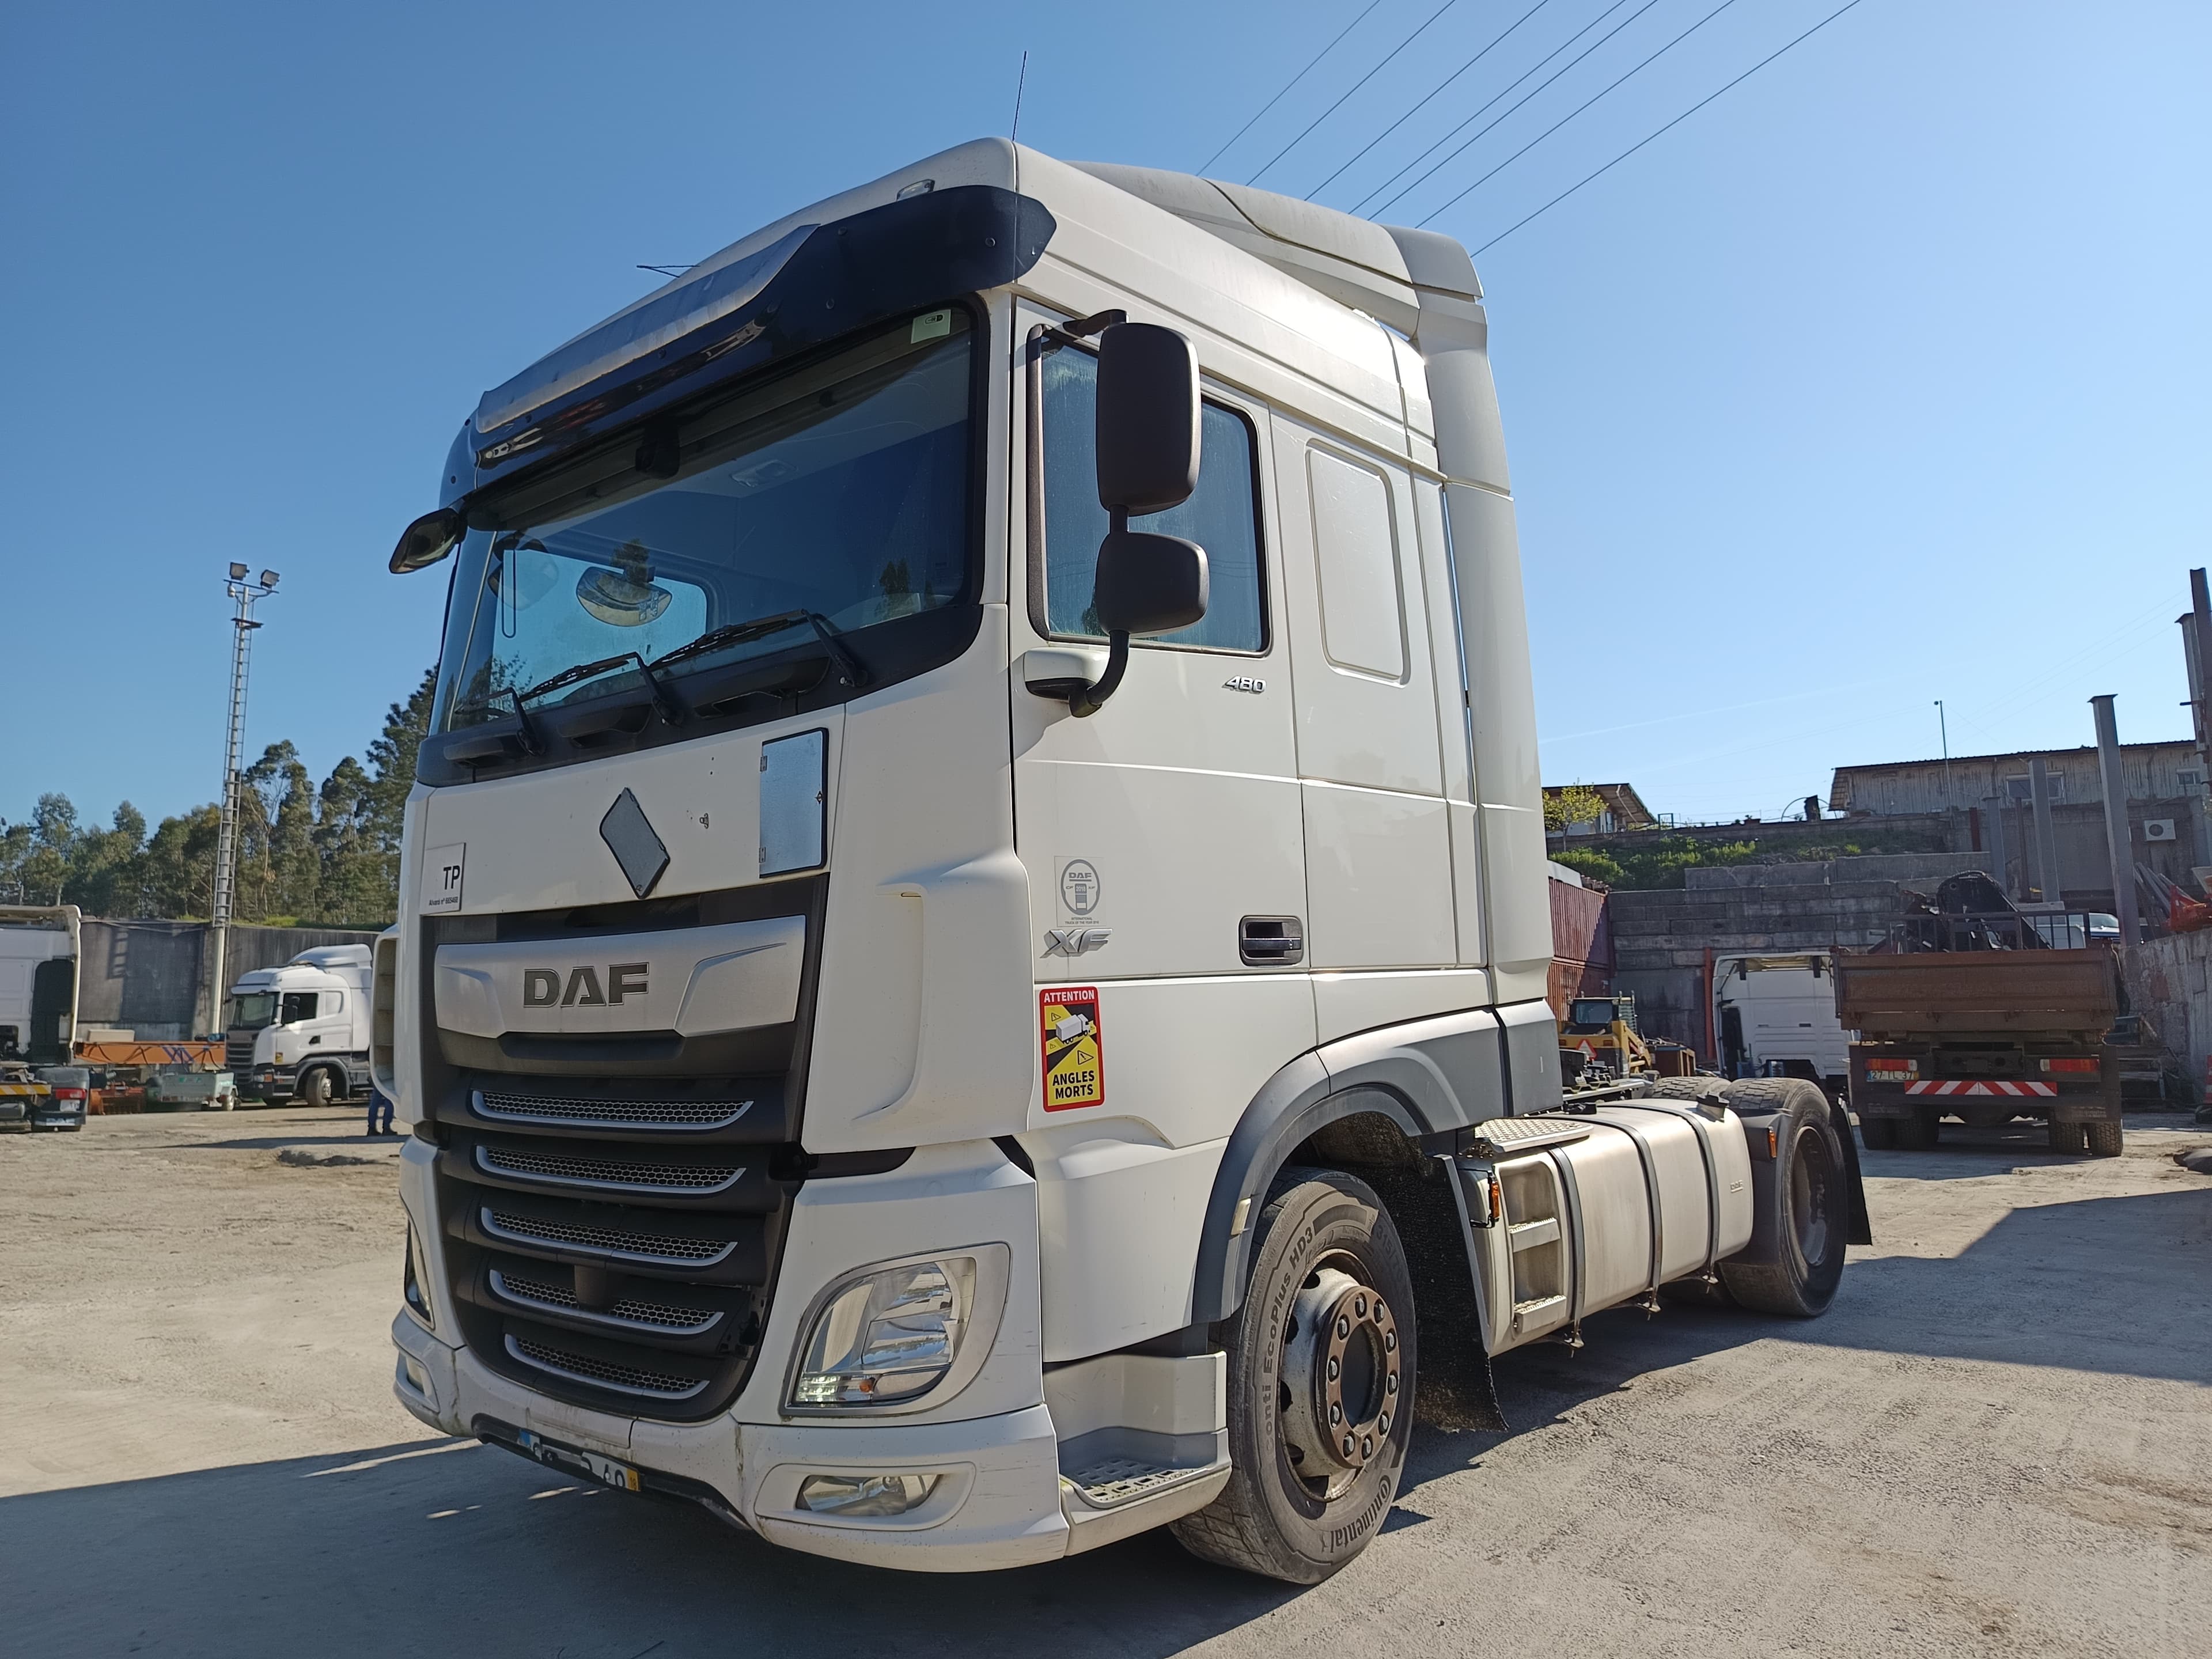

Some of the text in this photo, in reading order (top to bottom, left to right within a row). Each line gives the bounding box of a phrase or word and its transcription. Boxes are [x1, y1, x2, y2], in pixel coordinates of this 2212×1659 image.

[1224, 676, 1267, 693] 480
[443, 865, 460, 890] TP
[1041, 928, 1113, 957] XF
[524, 961, 649, 1008] DAF
[1043, 989, 1095, 1003] ATTENTION
[1052, 1070, 1095, 1086] ANGLES
[1055, 1084, 1094, 1100] MORTS
[1263, 1272, 1291, 1374] EcoPlus
[1289, 1226, 1313, 1270] HD3
[1330, 1475, 1391, 1554] Continental
